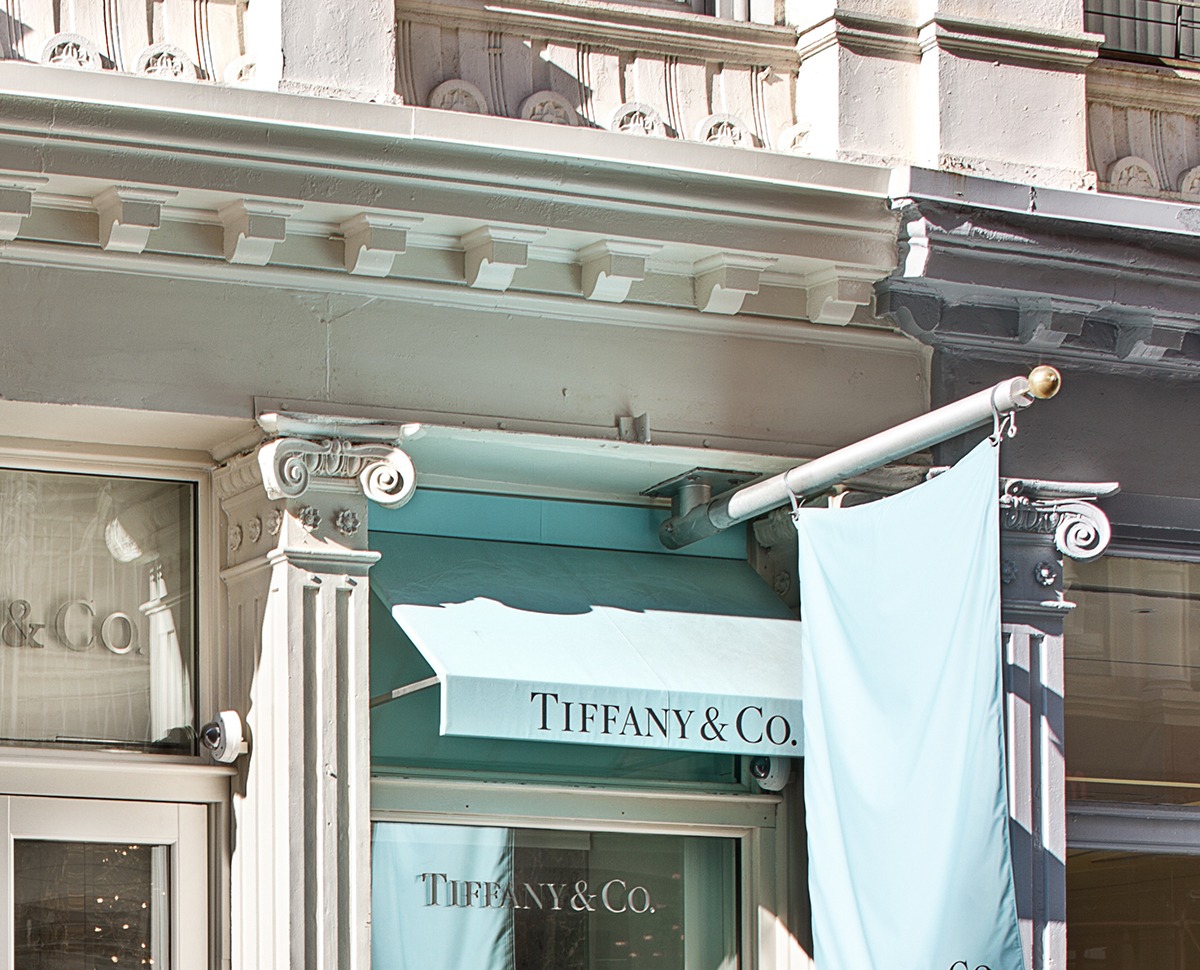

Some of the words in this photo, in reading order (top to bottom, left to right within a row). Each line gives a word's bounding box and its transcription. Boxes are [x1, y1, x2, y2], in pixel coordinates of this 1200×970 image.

[1, 599, 44, 649] &
[530, 691, 695, 740] TIFFANY
[700, 706, 729, 742] &
[420, 872, 567, 910] TIFFANY
[570, 879, 597, 912] &
